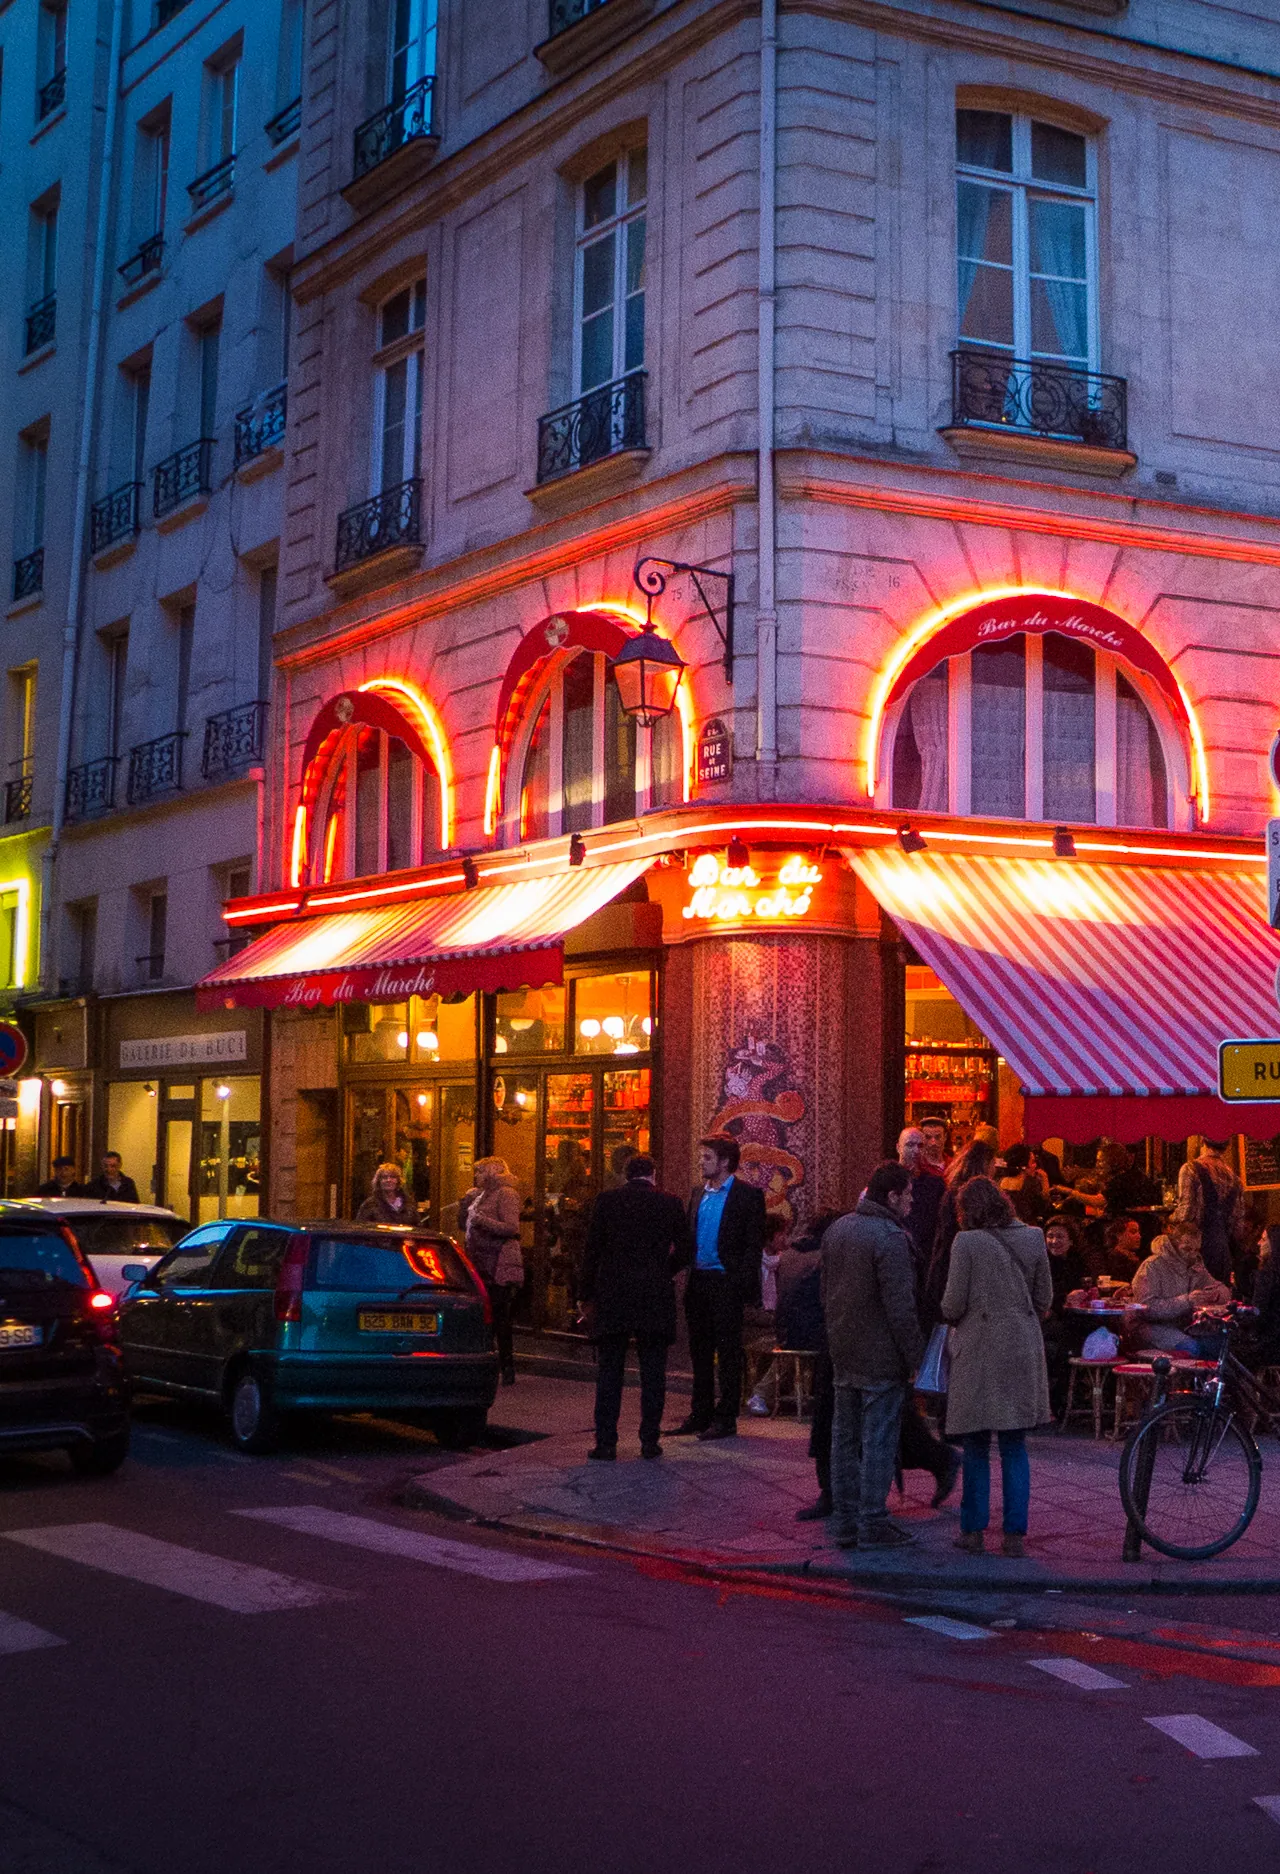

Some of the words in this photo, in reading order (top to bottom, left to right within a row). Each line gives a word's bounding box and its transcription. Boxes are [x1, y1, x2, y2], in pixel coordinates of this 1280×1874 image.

[977, 617, 1017, 637] Bar
[1021, 611, 1048, 626] du
[1054, 615, 1124, 647] Marché
[703, 743, 721, 758] RUE
[699, 764, 726, 780] SEINE
[688, 853, 761, 887] Bar
[778, 855, 823, 884] du
[682, 885, 814, 920] Marché
[284, 977, 321, 1002] Bar
[332, 974, 354, 998] du
[365, 965, 436, 996] Marché
[122, 1042, 172, 1062] GALERIE
[180, 1040, 197, 1058] DE
[206, 1036, 244, 1056] BUCI
